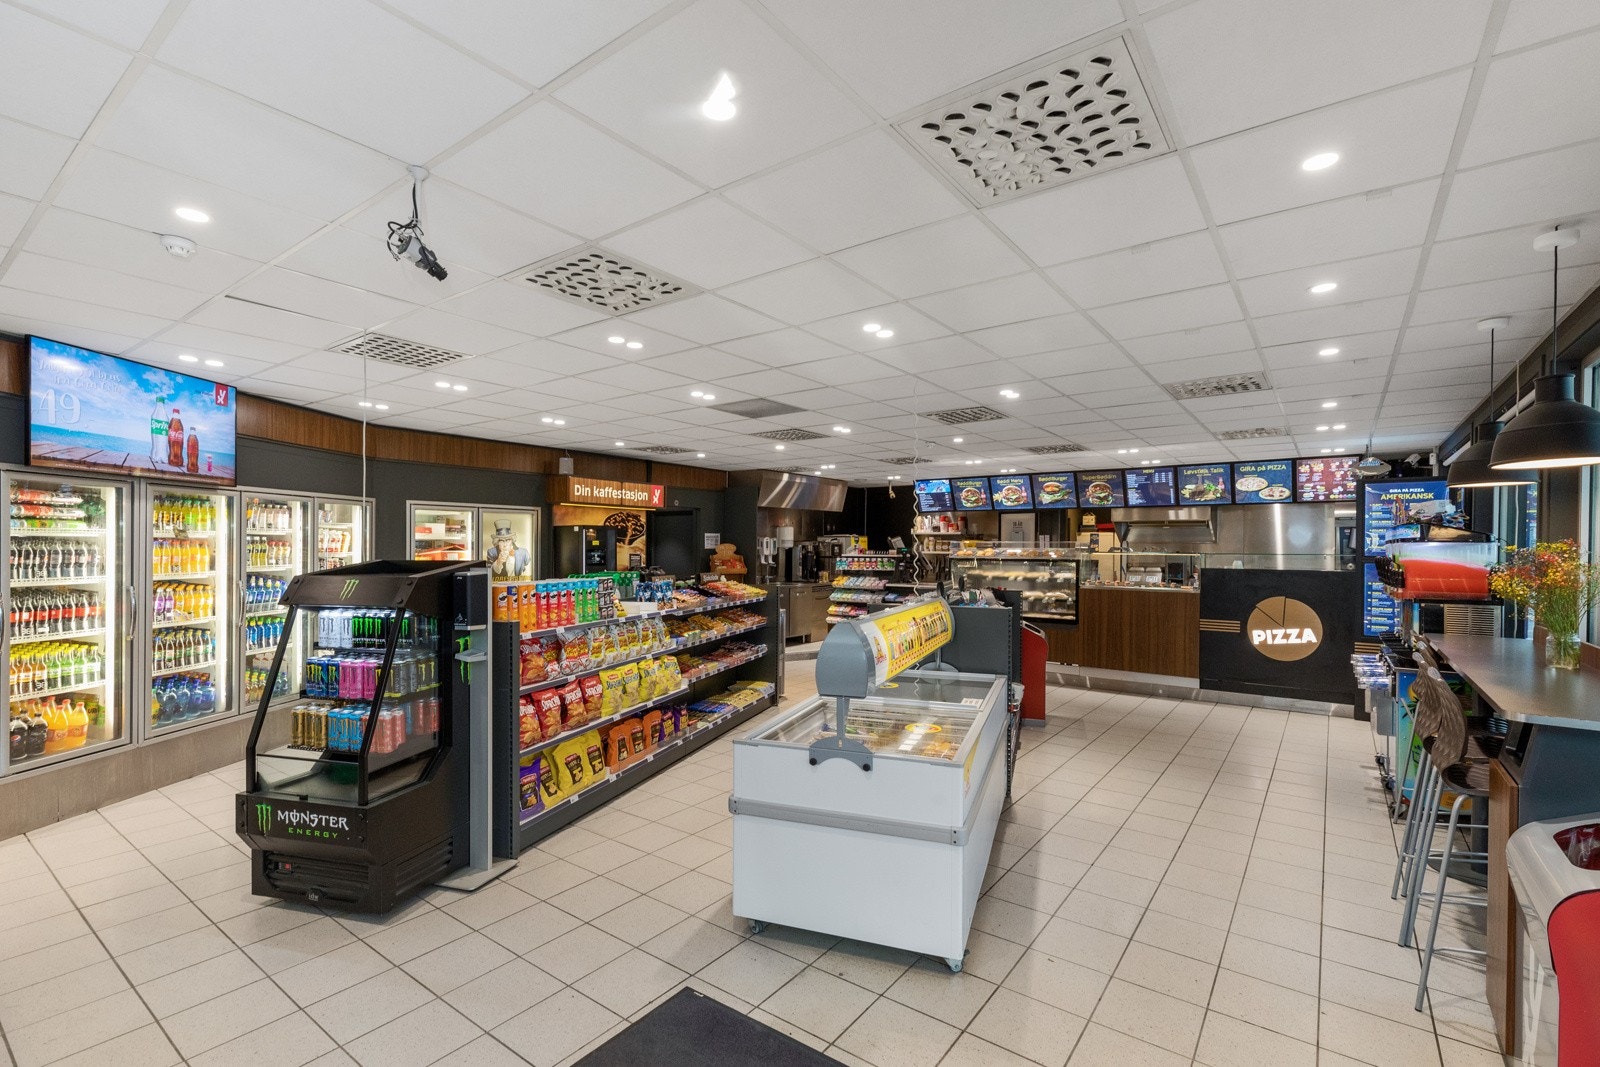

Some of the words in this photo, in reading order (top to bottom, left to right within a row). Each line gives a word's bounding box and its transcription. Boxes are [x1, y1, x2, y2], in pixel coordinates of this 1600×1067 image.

[574, 484, 591, 496] Din
[593, 486, 648, 501] kaffestasjon
[1251, 627, 1318, 645] PIZZA
[277, 808, 350, 831] MONSTER
[288, 827, 338, 839] ENERGY
